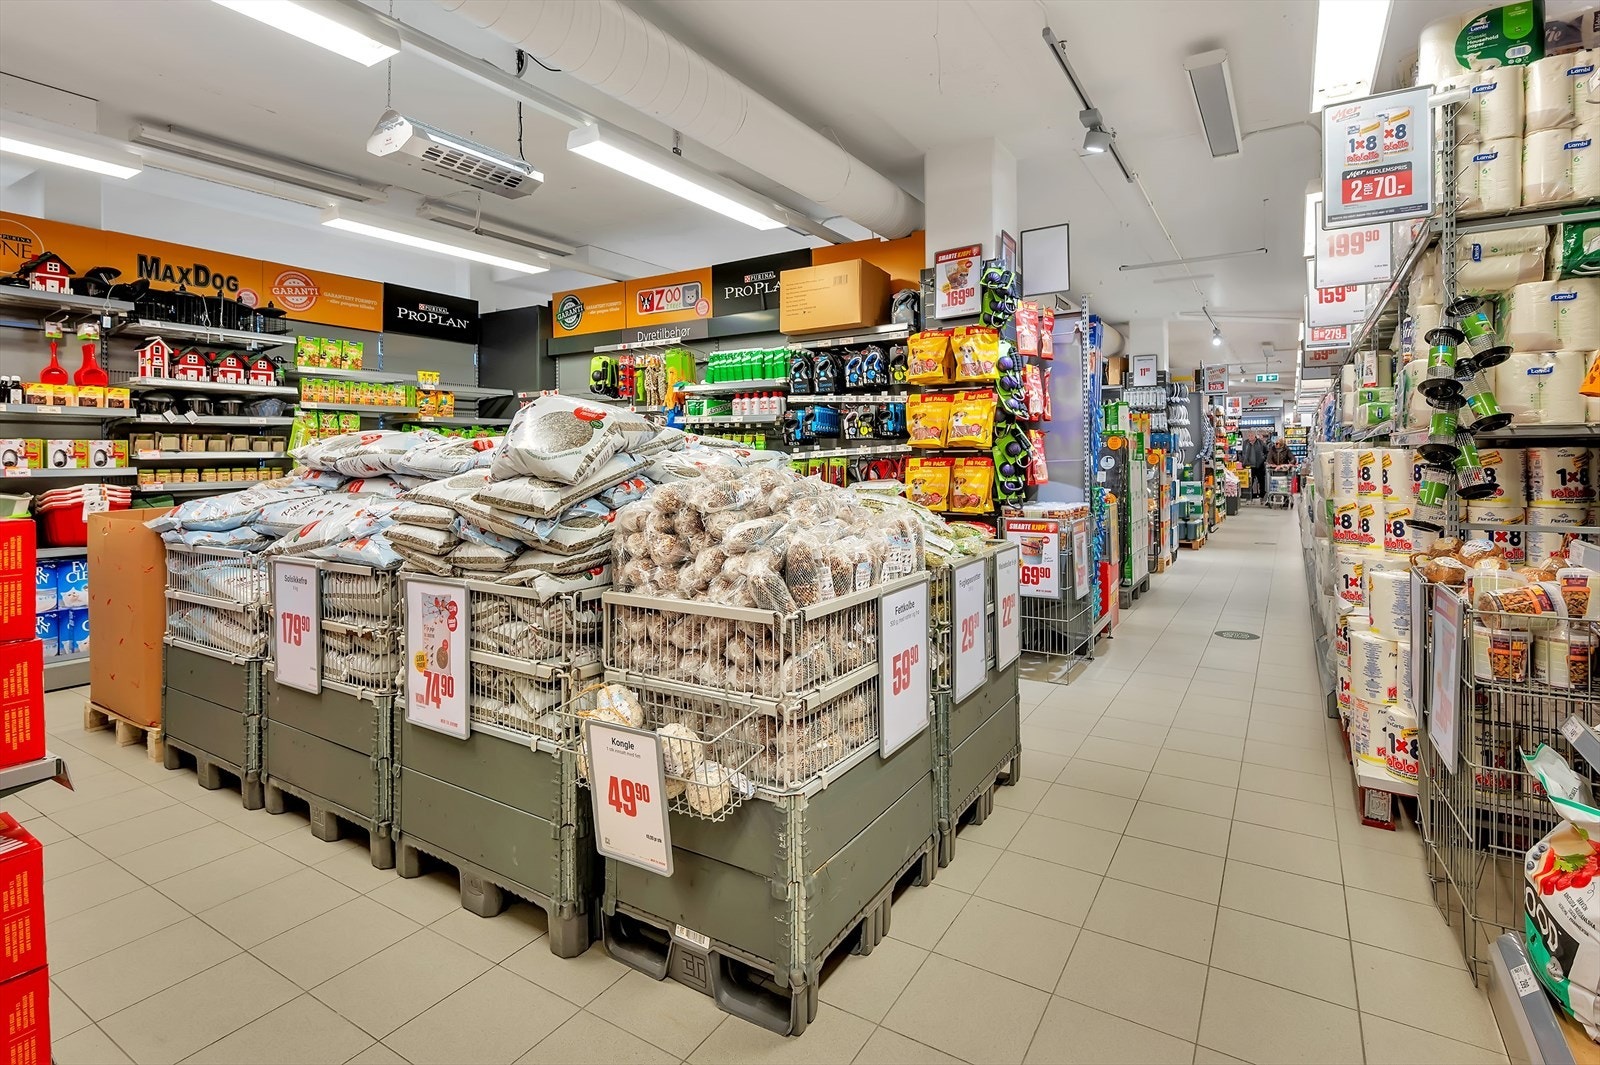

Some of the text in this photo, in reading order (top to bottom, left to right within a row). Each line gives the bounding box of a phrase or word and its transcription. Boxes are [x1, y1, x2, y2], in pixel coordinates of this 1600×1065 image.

[1470, 24, 1488, 32] Lambi
[1570, 66, 1592, 75] Lambi
[1476, 84, 1494, 92] Lambi
[1384, 124, 1407, 139] x8
[1349, 135, 1377, 153] 1x8
[1568, 140, 1588, 148] Lambi
[1476, 153, 1495, 162] Lambi
[1347, 165, 1408, 179] Mer MEDLEMSPRIS
[1351, 180, 1363, 201] 2
[0, 239, 32, 259] NE
[558, 305, 583, 320] GARANTI
[1555, 468, 1590, 486] 1x8
[72, 562, 88, 572] EV
[66, 571, 88, 583] CLE
[611, 737, 634, 750] Kongle
